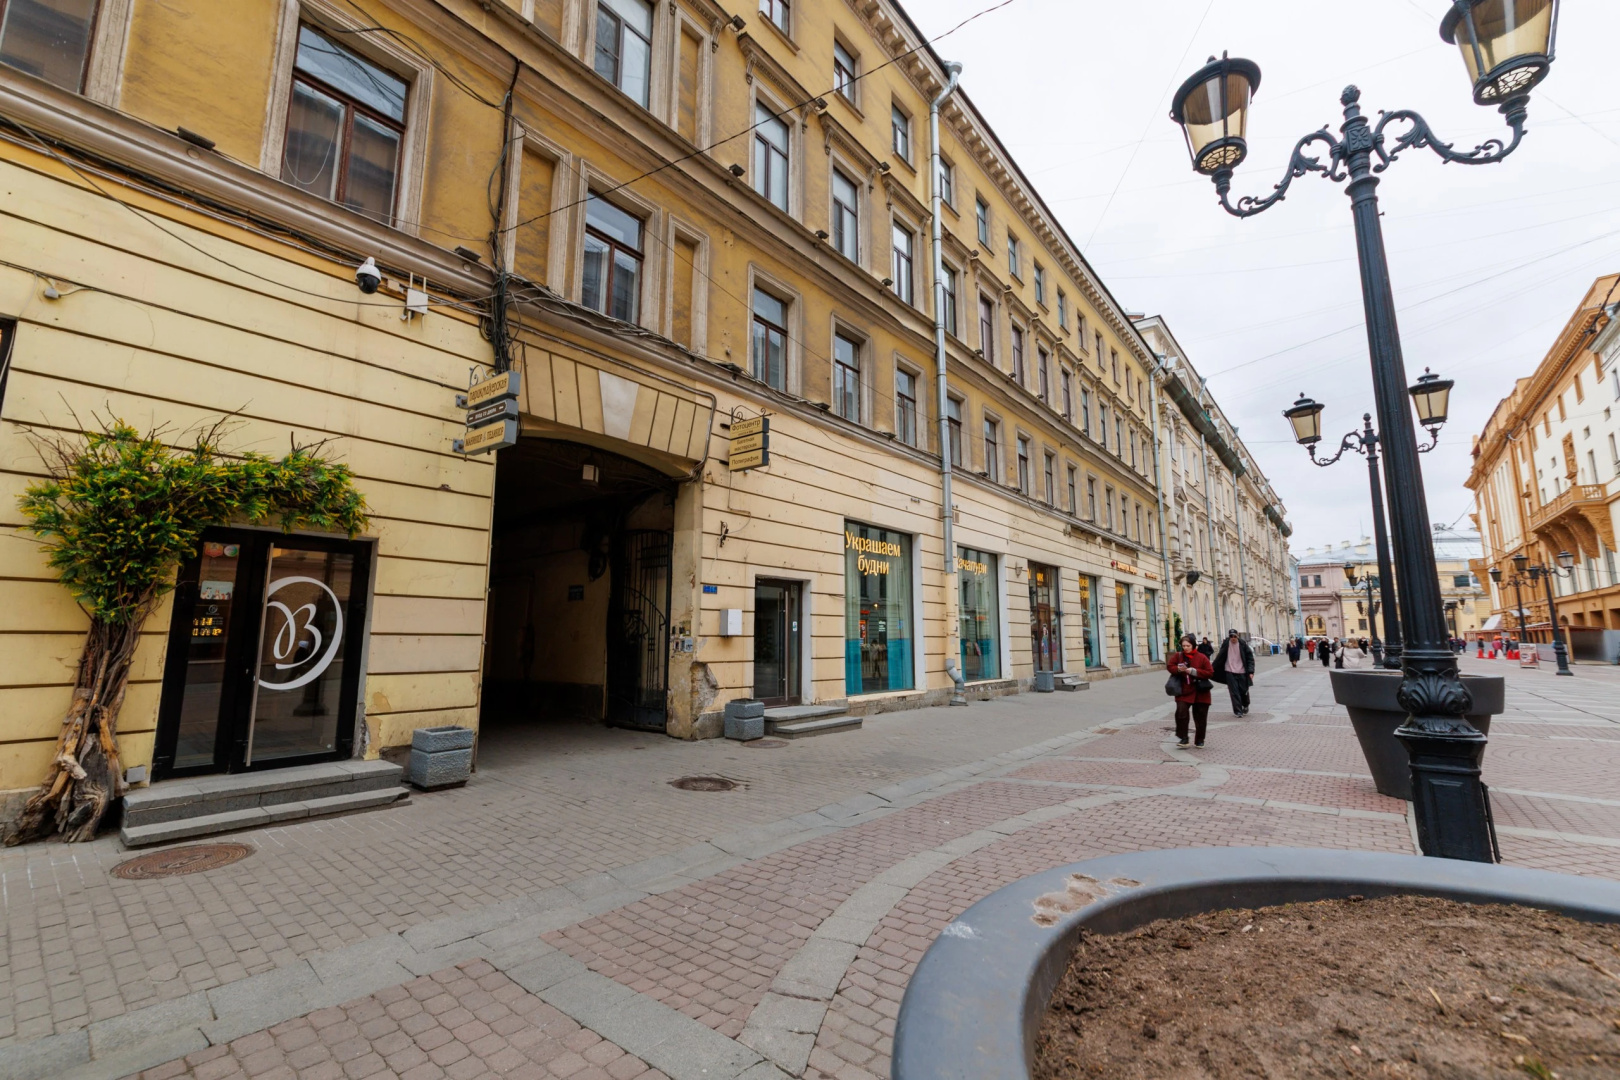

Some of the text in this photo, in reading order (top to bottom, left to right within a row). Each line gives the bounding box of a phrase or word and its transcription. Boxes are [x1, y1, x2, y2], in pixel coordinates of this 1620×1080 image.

[732, 419, 760, 431] Фотоцентр
[845, 531, 901, 557] Украшаем
[858, 554, 889, 576] будни
